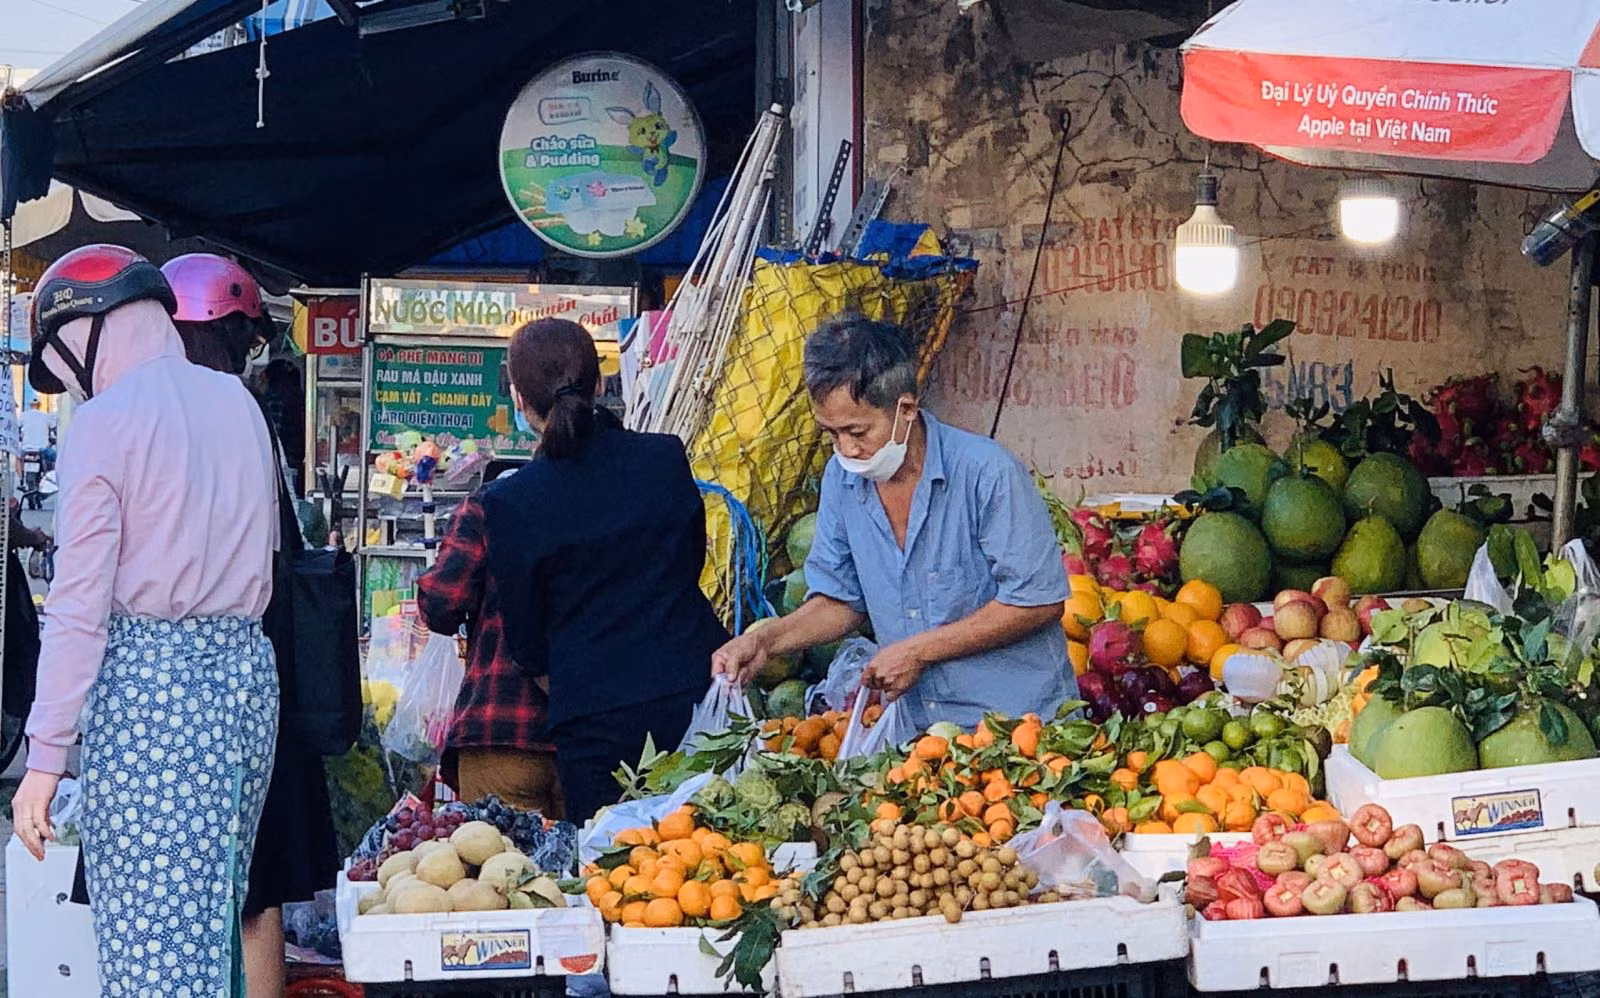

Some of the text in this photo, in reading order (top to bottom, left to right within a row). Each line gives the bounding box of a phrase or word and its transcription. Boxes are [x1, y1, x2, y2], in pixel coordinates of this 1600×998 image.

[572, 69, 620, 84] Burine
[1261, 80, 1289, 106] Đại
[1293, 83, 1313, 107] Lý
[1401, 89, 1451, 111] Chính
[1456, 92, 1499, 115] Thức
[1297, 113, 1451, 145] Apple tại Việt Nam
[531, 134, 597, 151] Cháo sữa
[525, 153, 600, 168] & Pudding
[426, 350, 465, 366] MANG
[376, 370, 399, 382] RAU
[402, 368, 421, 384] MÁ
[451, 372, 483, 386] XANH
[376, 390, 399, 404] CAM
[431, 392, 469, 406] CHANH
[440, 412, 474, 430] THOẠI
[1487, 798, 1536, 824] WINNER
[476, 938, 526, 961] WINNER
